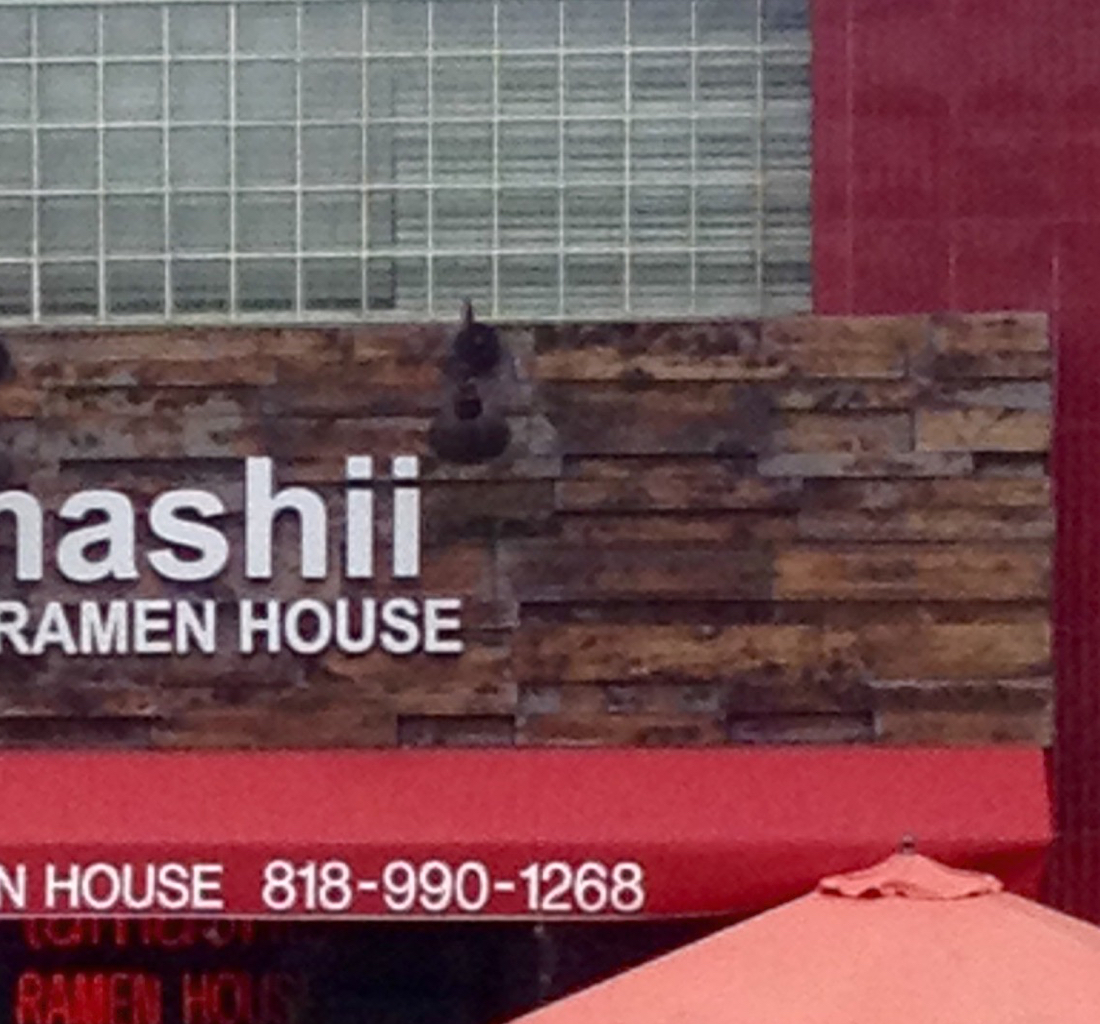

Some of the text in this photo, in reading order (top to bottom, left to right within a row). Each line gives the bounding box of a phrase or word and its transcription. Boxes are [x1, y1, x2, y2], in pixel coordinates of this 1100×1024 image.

[238, 597, 463, 655] HOUSE
[44, 863, 223, 911] HOUSE
[262, 859, 645, 912] 818-990-1268
